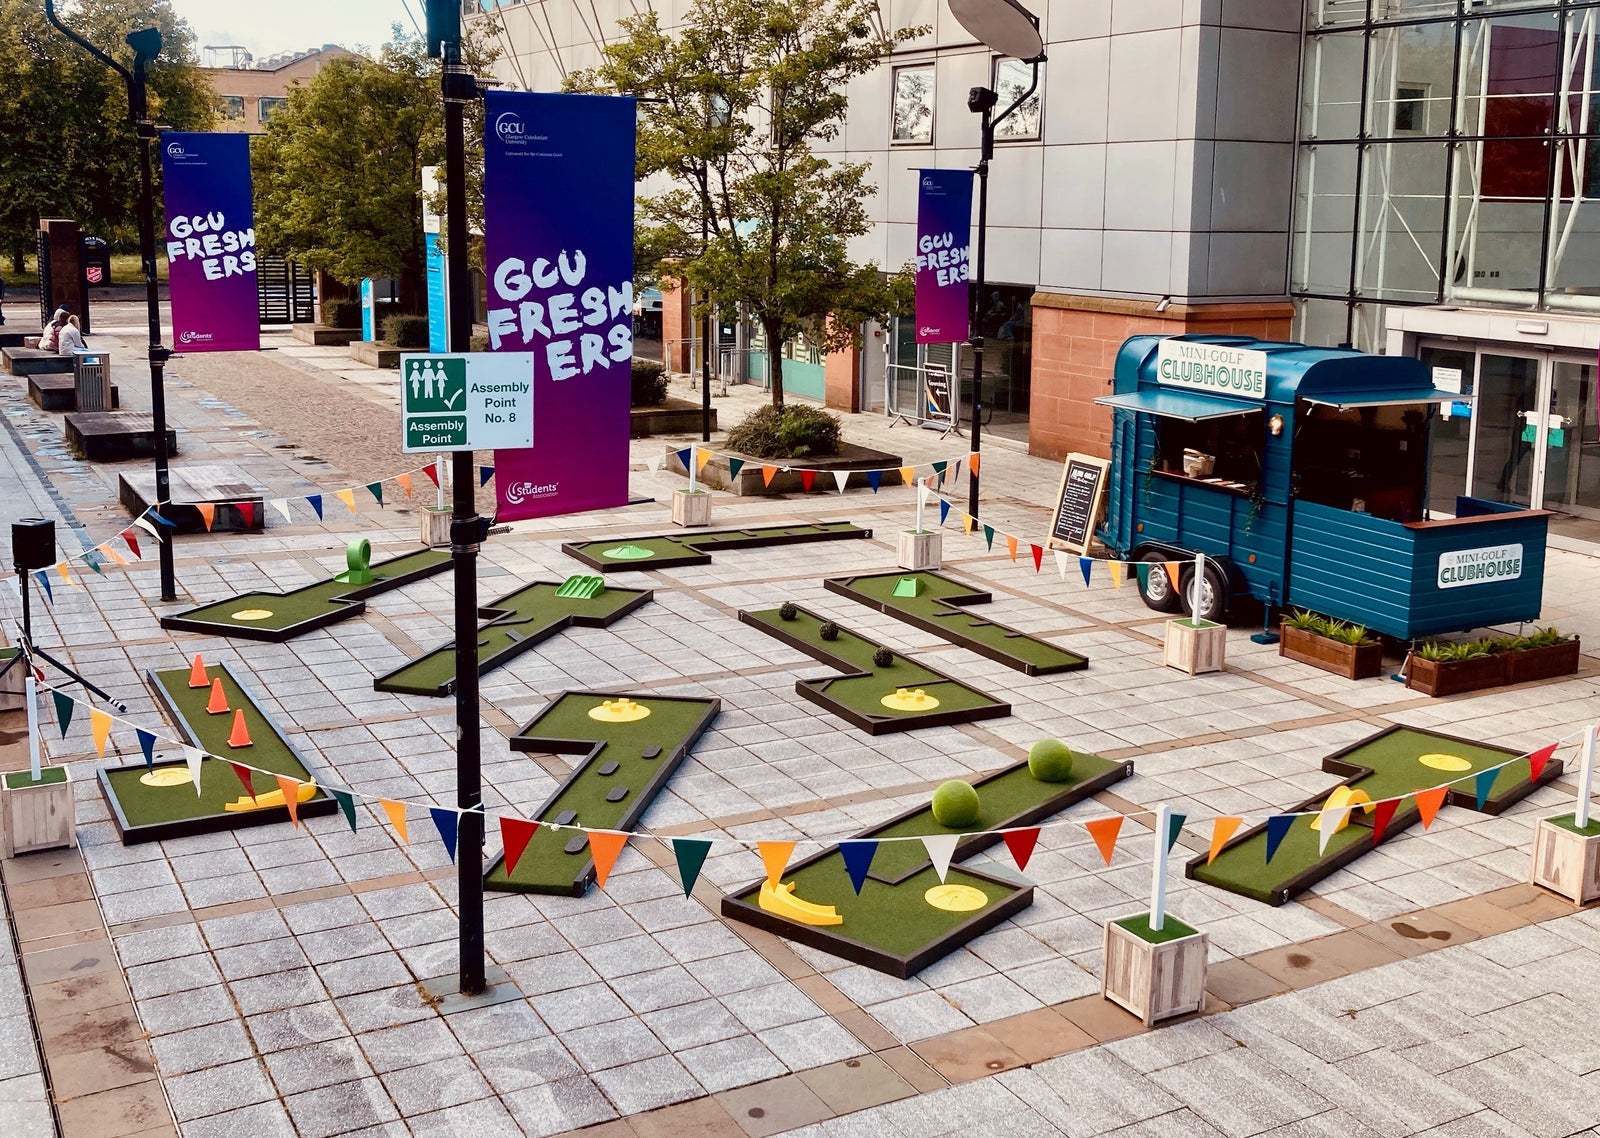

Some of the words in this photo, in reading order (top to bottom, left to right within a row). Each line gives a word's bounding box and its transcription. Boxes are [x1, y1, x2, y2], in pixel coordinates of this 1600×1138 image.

[499, 122, 525, 134] GCU
[170, 211, 225, 239] GCU
[166, 228, 256, 263] FRESH
[919, 231, 953, 253] GCU
[202, 250, 257, 280] ERS
[916, 245, 969, 273] FRESH
[494, 249, 587, 302] GCU
[936, 263, 969, 287] ERS
[487, 281, 632, 351] FRESH
[546, 324, 632, 381] ERS
[1179, 346, 1245, 365] MINI-GOLF
[1160, 358, 1263, 393] CLUBHOUSE
[470, 382, 530, 394] Assembly
[485, 398, 516, 408] Point
[409, 420, 464, 432] Assembly
[485, 413, 506, 424] No.
[508, 412, 516, 423] 8
[422, 434, 452, 444] Point
[865, 530, 870, 538] 2
[1456, 549, 1507, 565] MINI-GOLF
[1440, 558, 1520, 584] CLUBHOUSE
[1126, 765, 1131, 776] 8
